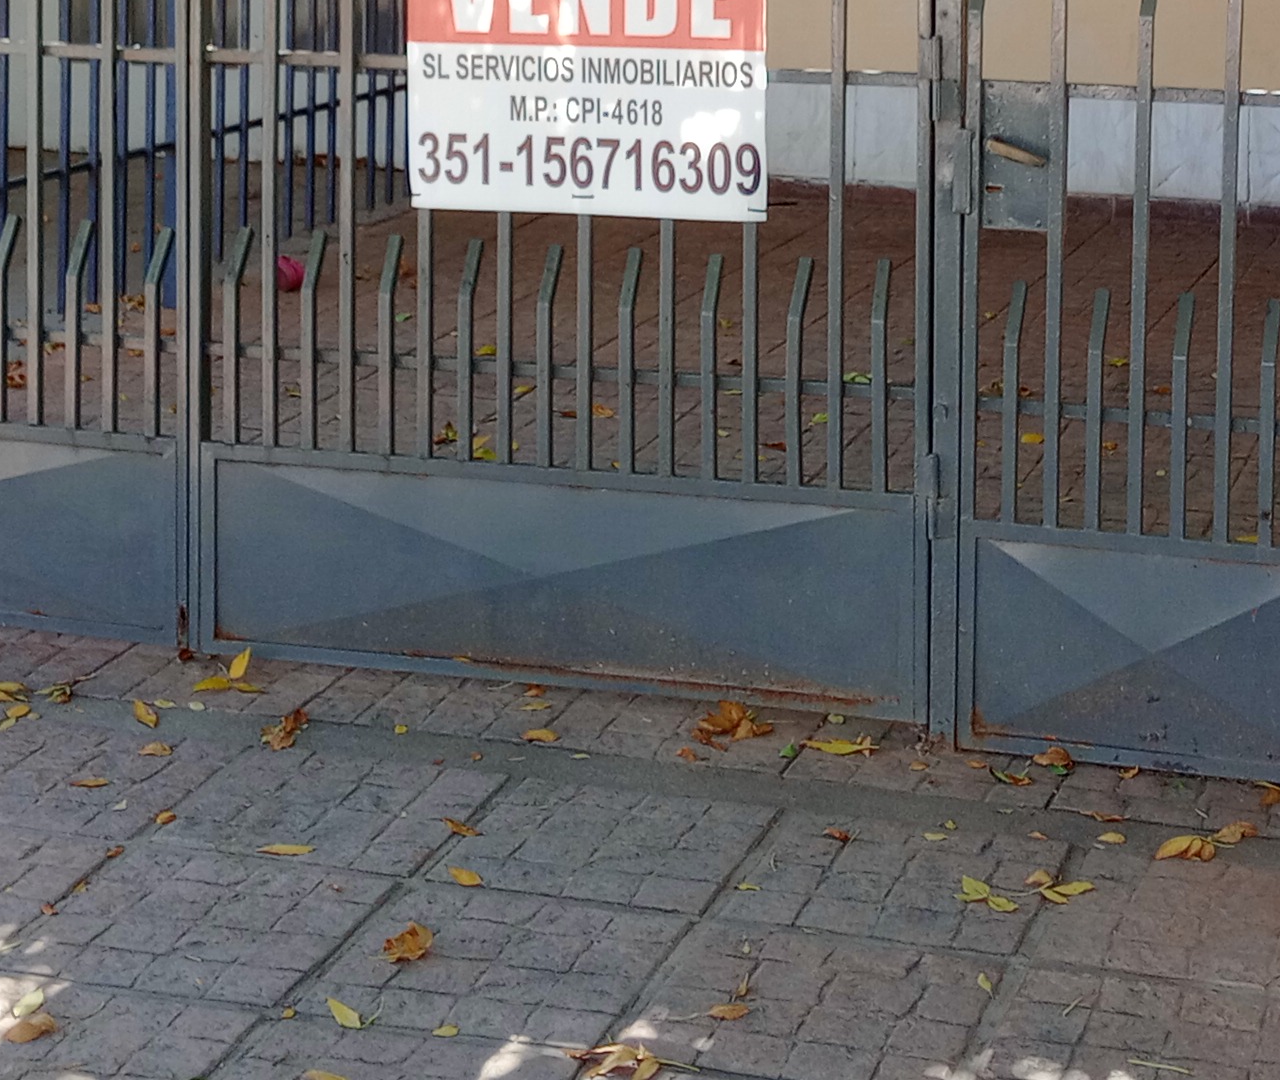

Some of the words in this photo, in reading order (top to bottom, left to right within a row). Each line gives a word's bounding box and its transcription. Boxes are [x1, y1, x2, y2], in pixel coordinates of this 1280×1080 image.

[422, 53, 450, 80] SL
[456, 54, 575, 84] SERVICIOS
[581, 57, 754, 89] INMOBILIARIOS
[510, 95, 558, 123] M.P.:
[565, 97, 663, 126] CPI-4618
[417, 131, 762, 197] 351-156716309
